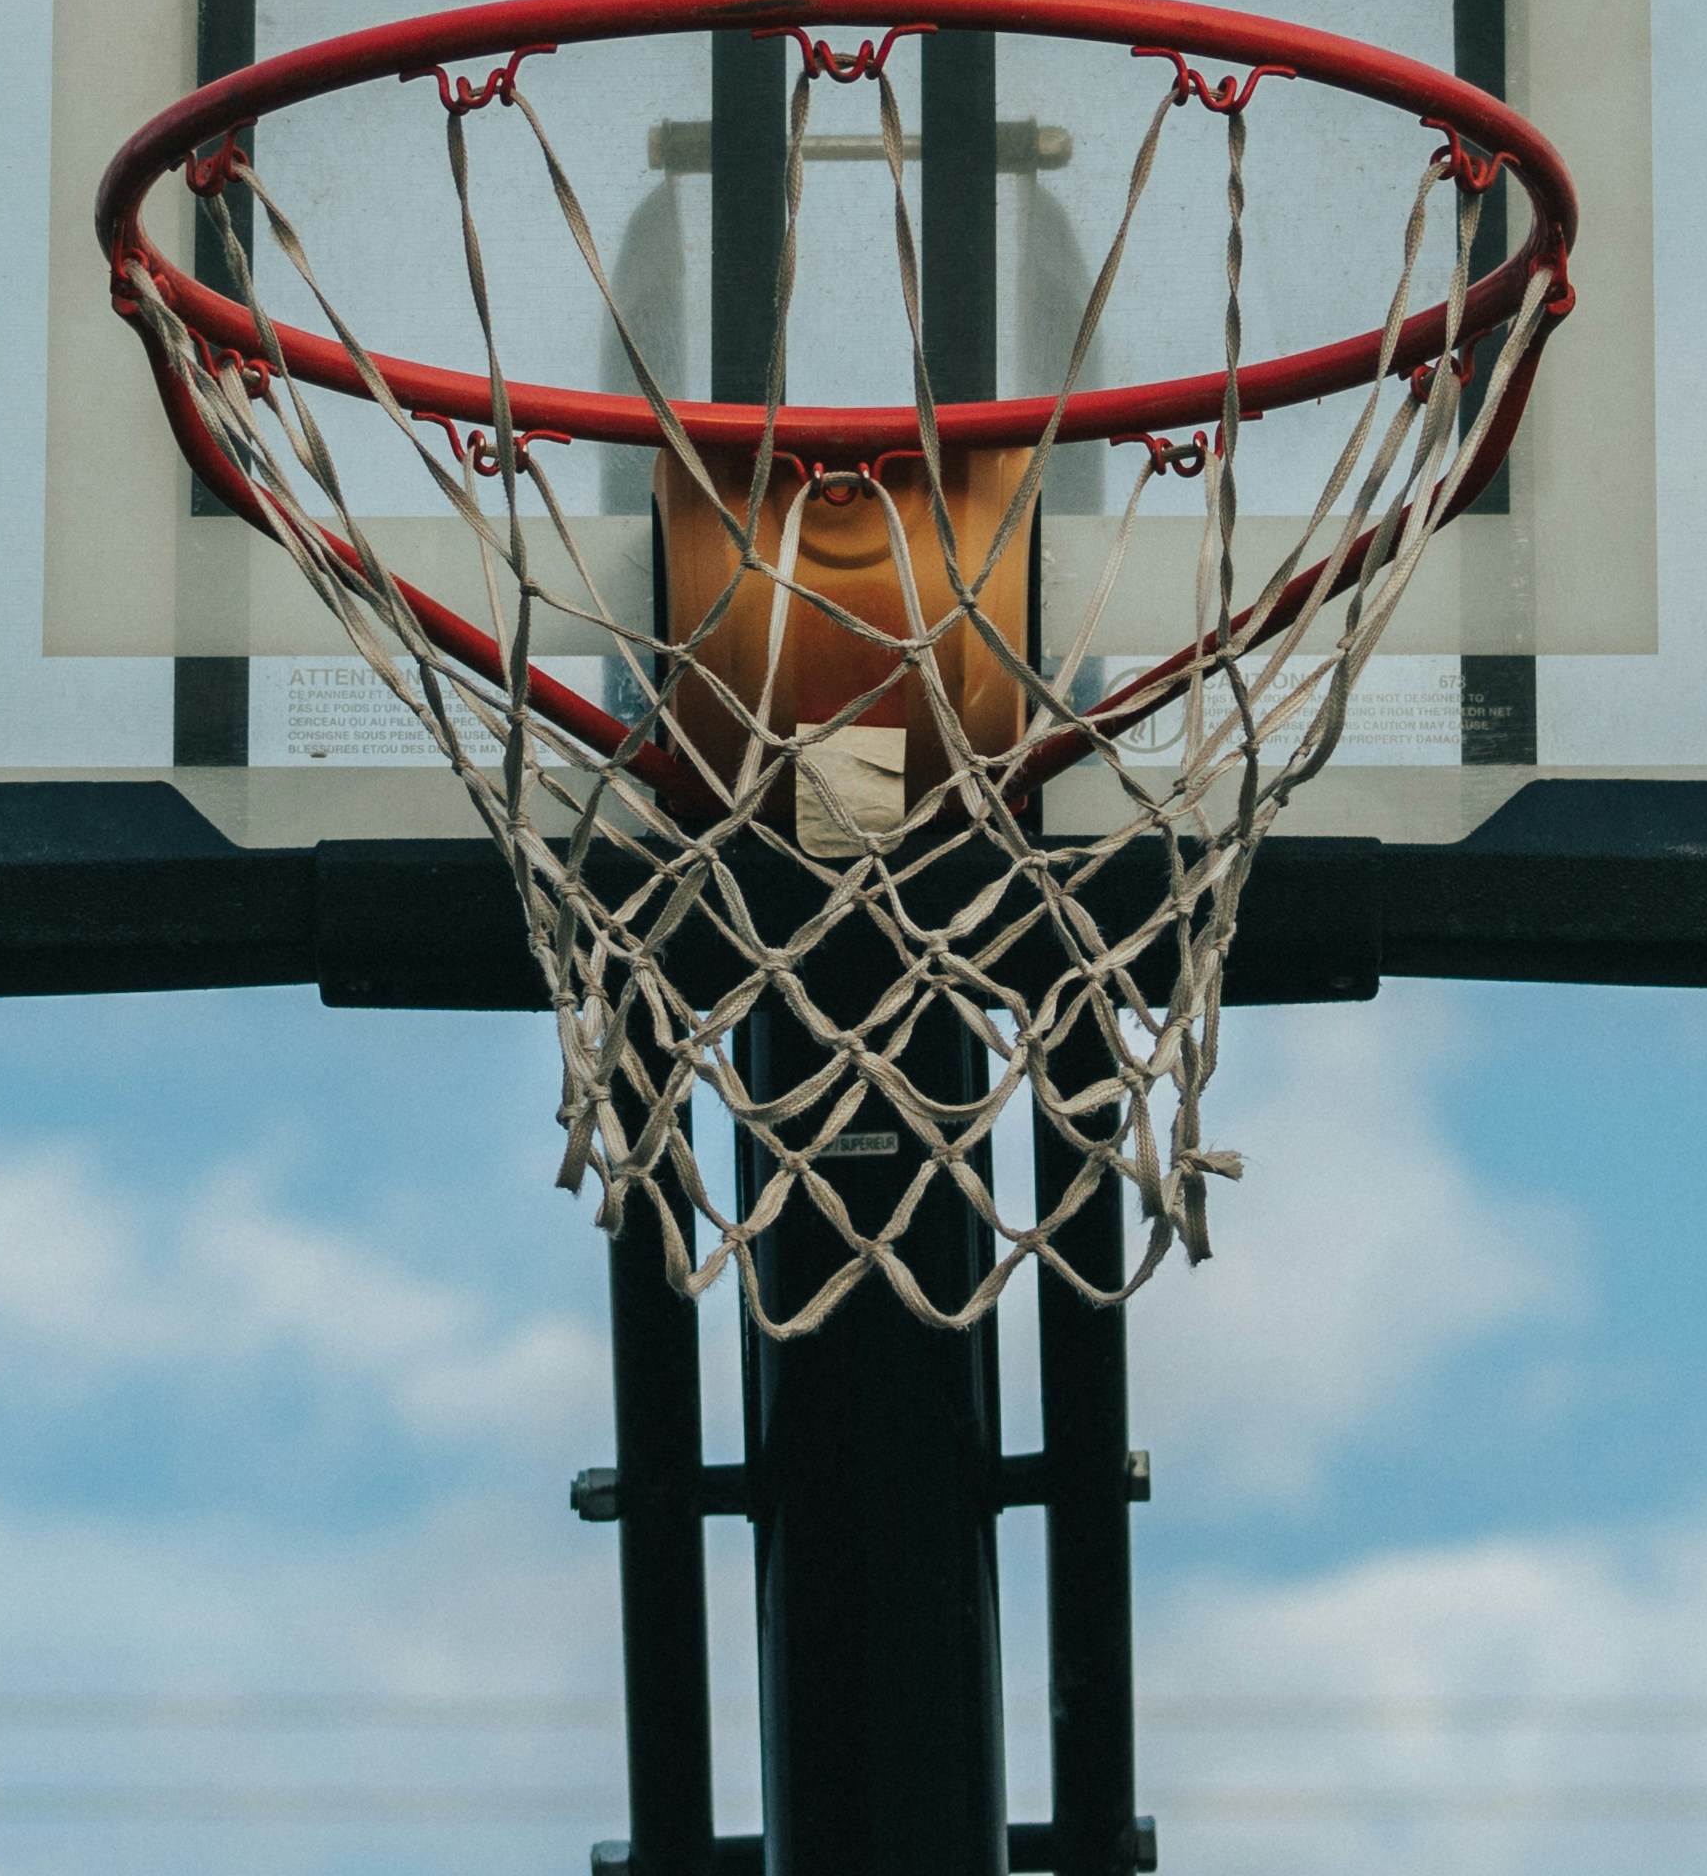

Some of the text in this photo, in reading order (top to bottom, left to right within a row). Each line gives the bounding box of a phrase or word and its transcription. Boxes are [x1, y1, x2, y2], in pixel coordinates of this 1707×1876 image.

[287, 668, 421, 686] ATTENTN
[288, 690, 306, 700] CE
[308, 690, 366, 700] PANNEAU
[369, 690, 386, 700] ET
[1363, 693, 1373, 703] IS
[1376, 693, 1400, 703] NOT
[1404, 693, 1465, 703] DESIGNED
[1467, 693, 1484, 703] TO
[288, 703, 313, 713] PAS
[315, 703, 331, 713] LE
[334, 703, 370, 713] POIDS
[373, 703, 401, 713] D'UN
[1347, 707, 1376, 717] GING
[1380, 707, 1414, 717] FROM
[1418, 707, 1441, 717] THE
[1467, 707, 1486, 717] OR
[1488, 707, 1513, 717] NET
[288, 717, 346, 727] CERCEAU
[349, 717, 366, 727] OU
[370, 717, 387, 727] AU
[1363, 721, 1416, 730] CAUTION
[1419, 721, 1444, 730] MAY
[1448, 721, 1490, 730] CAUSE
[288, 731, 350, 740] CONSIGNE
[353, 731, 386, 740] SOUS
[389, 731, 424, 740] PEINE
[1348, 735, 1413, 744] PROPERTY
[288, 744, 359, 754] BLESSURES
[362, 744, 398, 754] ET/OU
[401, 744, 425, 754] DES
